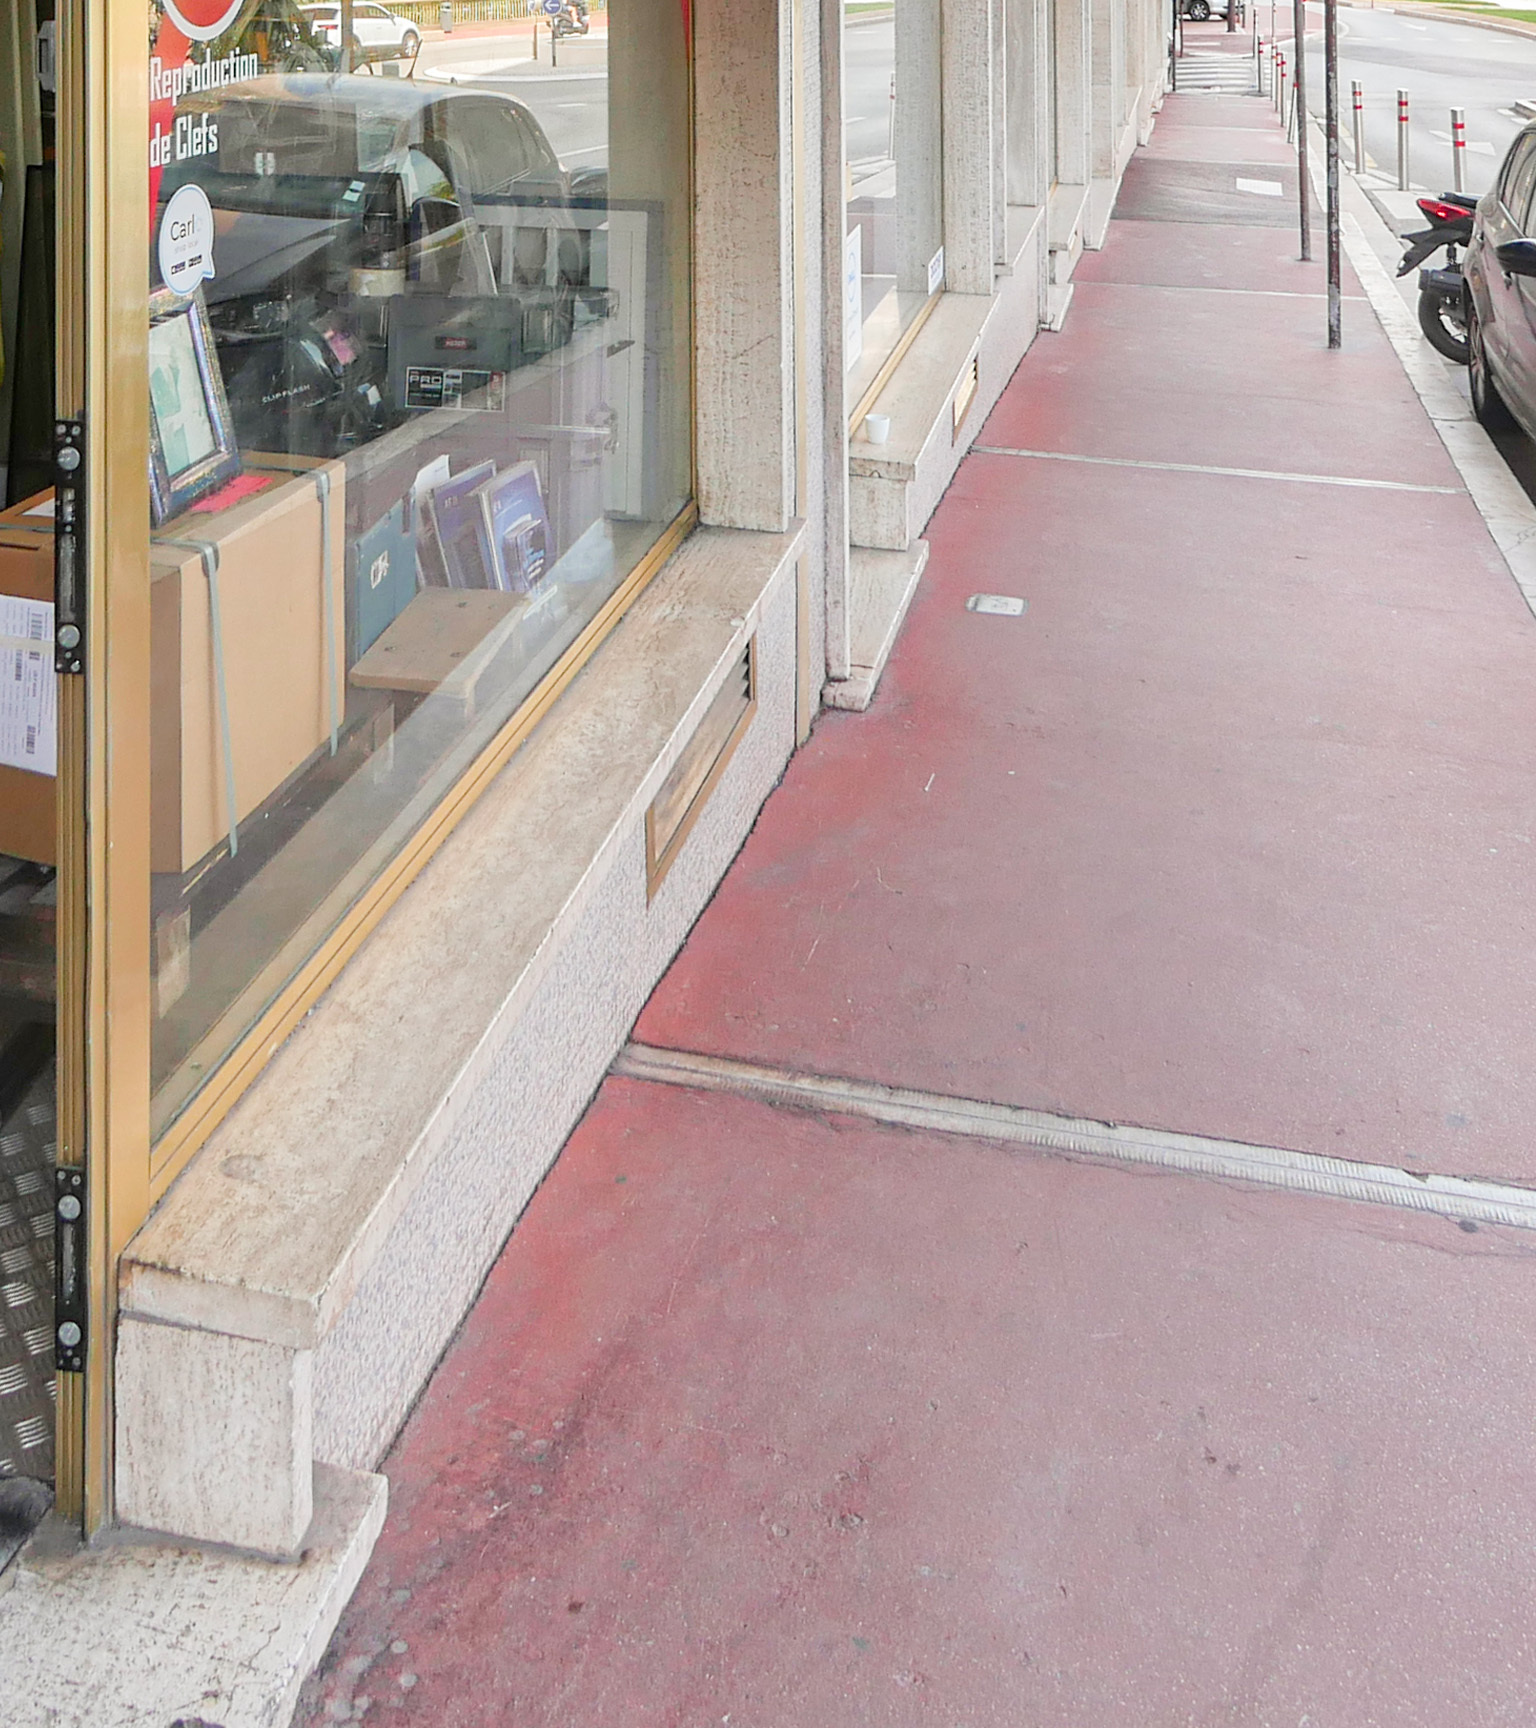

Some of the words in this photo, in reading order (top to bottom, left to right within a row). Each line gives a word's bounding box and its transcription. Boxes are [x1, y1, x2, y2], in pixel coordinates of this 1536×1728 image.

[150, 46, 258, 107] Reproduction
[149, 122, 171, 168] de
[175, 112, 218, 161] Clefs
